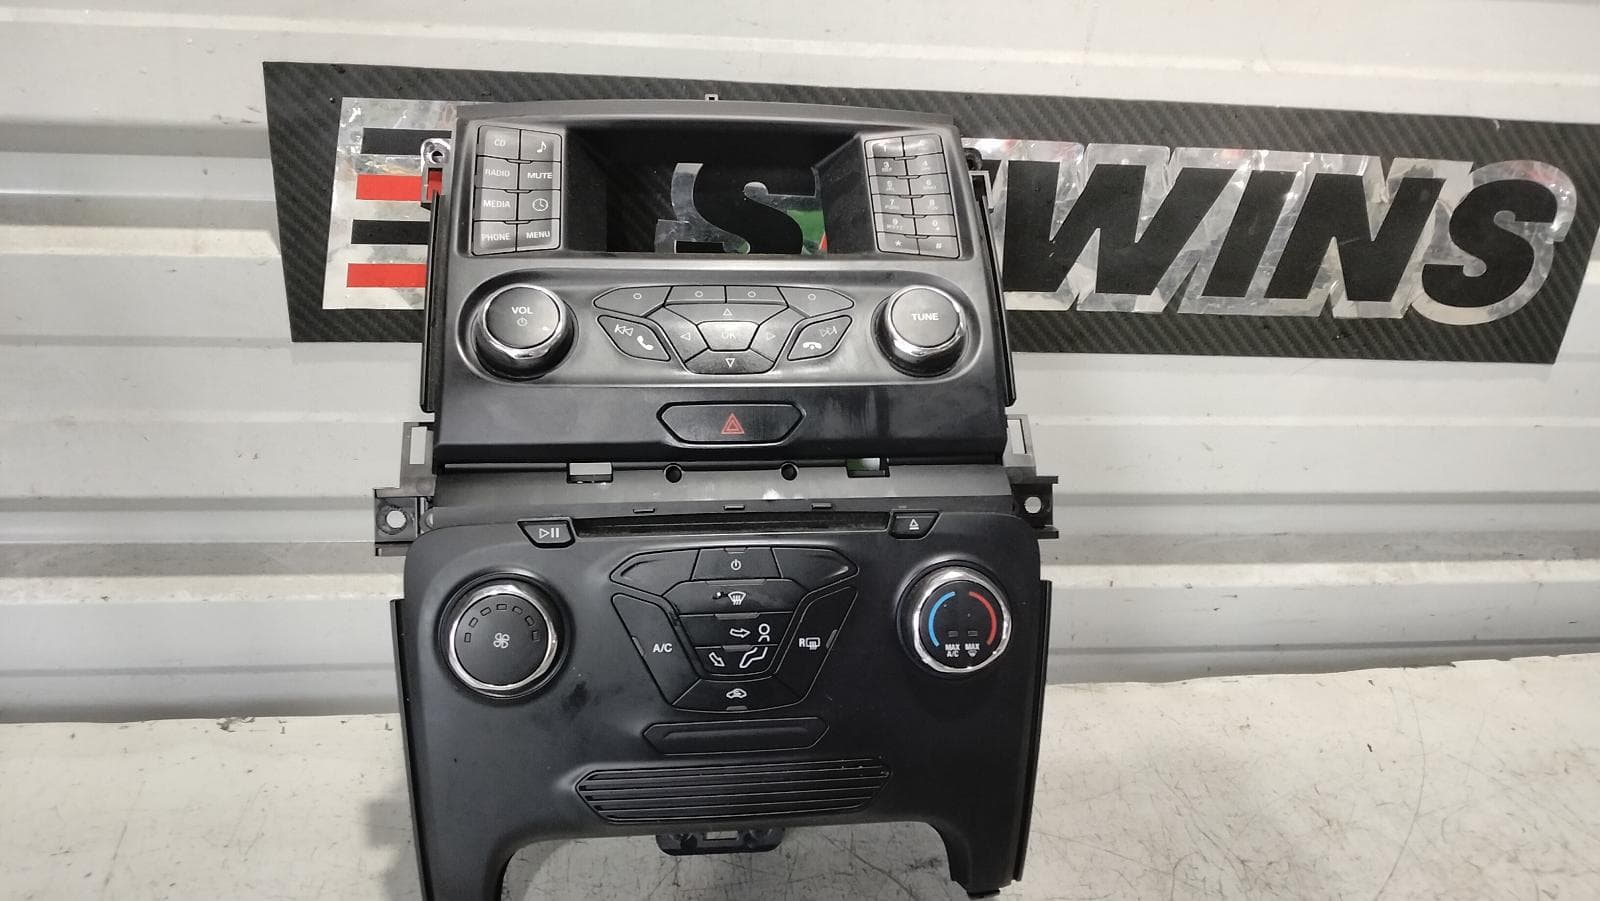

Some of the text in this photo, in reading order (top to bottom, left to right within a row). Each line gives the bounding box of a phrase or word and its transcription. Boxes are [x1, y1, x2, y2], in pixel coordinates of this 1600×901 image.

[494, 138, 506, 147] CD
[485, 168, 511, 178] RADIO
[483, 200, 511, 208] MEDIA
[480, 232, 511, 242] PHONE
[526, 230, 551, 239] MENU
[511, 306, 534, 315] VOL
[911, 312, 940, 321] TUNE
[652, 643, 673, 653] A/C
[945, 643, 960, 651] MAX
[947, 650, 960, 658] A/C
